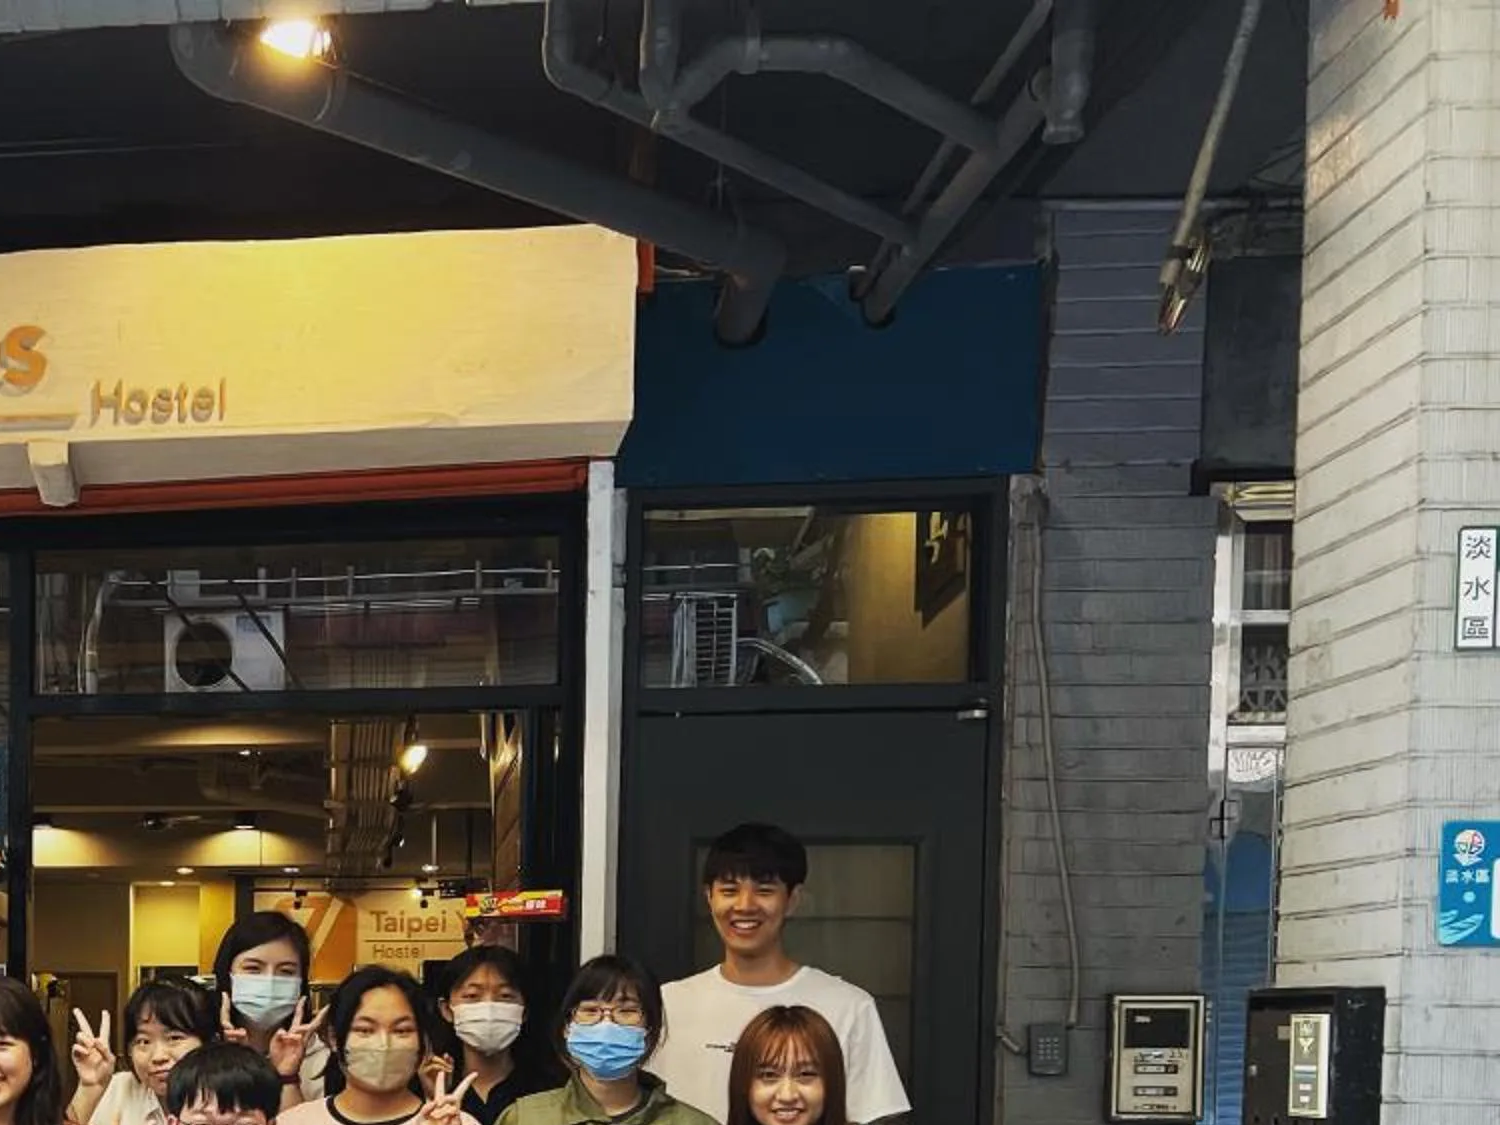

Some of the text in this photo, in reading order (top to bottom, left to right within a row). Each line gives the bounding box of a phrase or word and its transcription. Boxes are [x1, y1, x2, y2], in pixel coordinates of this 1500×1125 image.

[90, 378, 226, 428] Hostel
[1462, 534, 1492, 640] 淡水區
[369, 909, 447, 938] Taipei
[372, 943, 426, 959] Hostel
